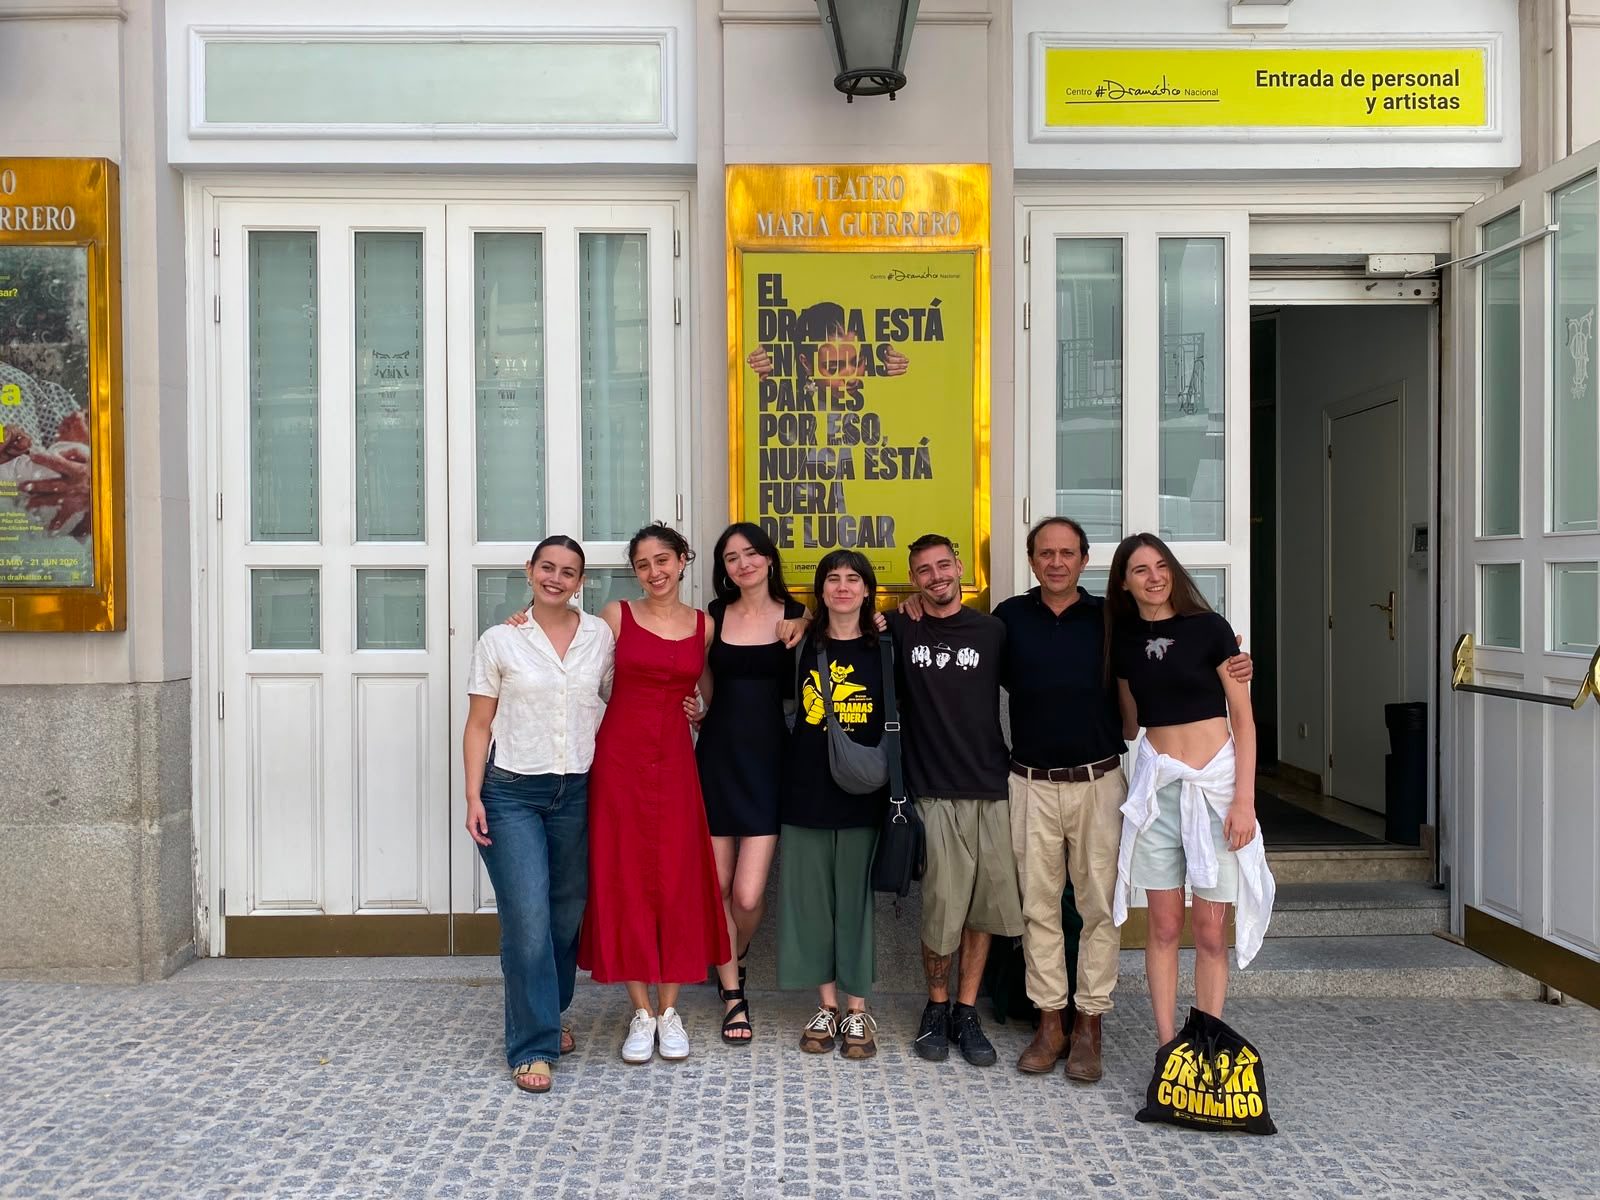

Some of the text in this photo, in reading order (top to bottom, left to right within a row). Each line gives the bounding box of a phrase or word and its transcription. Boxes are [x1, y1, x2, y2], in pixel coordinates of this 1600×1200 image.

[1066, 75, 1219, 99] Centro #Dramático Nacional
[1256, 69, 1459, 91] Entrada de personal
[1366, 93, 1460, 114] y artistas
[814, 175, 905, 201] TEATRO
[839, 211, 961, 237] GUERRERO
[758, 273, 788, 307] EL
[758, 297, 944, 342] DRAMA ESTÁ
[764, 343, 889, 377] EN TODAS
[759, 379, 865, 412] PARTES
[760, 413, 889, 447] POR ESO,
[760, 437, 933, 480] NUNCA ESTÁ
[760, 482, 846, 514] FUERA
[760, 516, 896, 549] DE LUGAR
[6, 558, 24, 566] MAY
[30, 558, 39, 566] 21
[41, 558, 57, 567] JUN
[59, 558, 79, 567] 2026
[833, 702, 873, 713] DRAMAS
[839, 713, 867, 723] FUERA
[1157, 1081, 1264, 1119] CONMIGO
